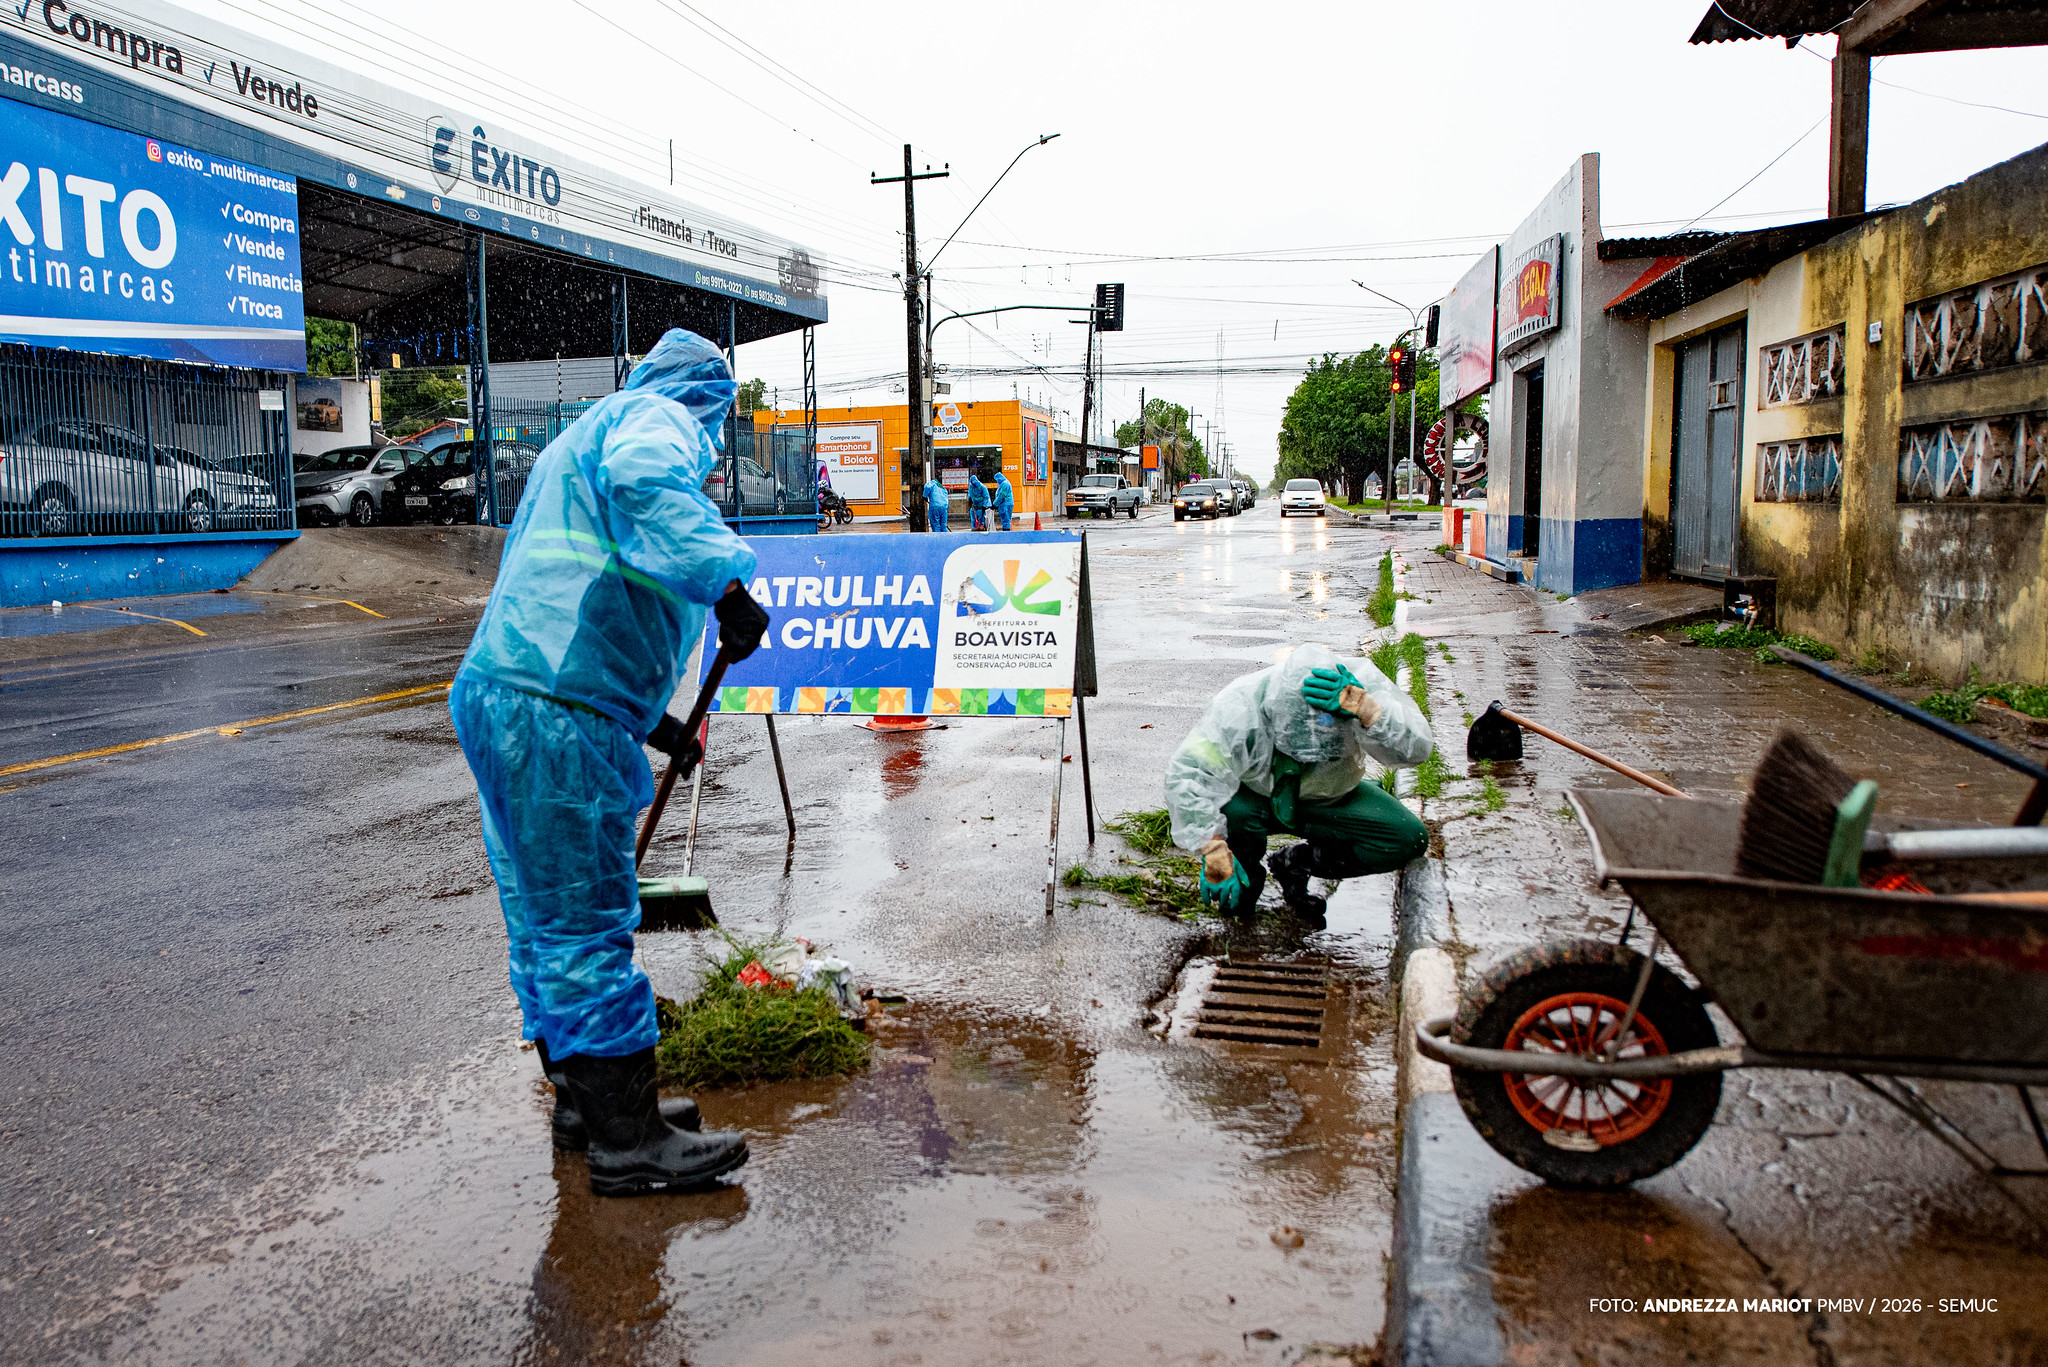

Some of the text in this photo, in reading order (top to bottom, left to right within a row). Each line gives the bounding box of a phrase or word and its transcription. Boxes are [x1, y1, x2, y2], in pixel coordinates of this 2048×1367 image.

[43, 0, 183, 75] Compra
[230, 60, 319, 118] Vende
[166, 150, 298, 195] exito_multimarcass
[471, 125, 561, 207] ÊXITO
[233, 203, 296, 234] Compra
[476, 186, 561, 225] multimarcas
[639, 205, 692, 244] Financia
[234, 233, 286, 261] Vende
[707, 229, 738, 258] Troca
[0, 247, 175, 305] timarcas
[237, 265, 303, 294] Financia
[1520, 263, 1546, 311] LEGAL
[238, 296, 283, 320] Troca
[932, 424, 968, 435] easytech
[820, 443, 868, 452] Smartphone
[843, 455, 875, 464] Boleto
[745, 575, 935, 607] ATRULHA
[781, 616, 931, 650] CHUVA
[956, 660, 1053, 670] CONSERVAÇÃO PÚBLICA
